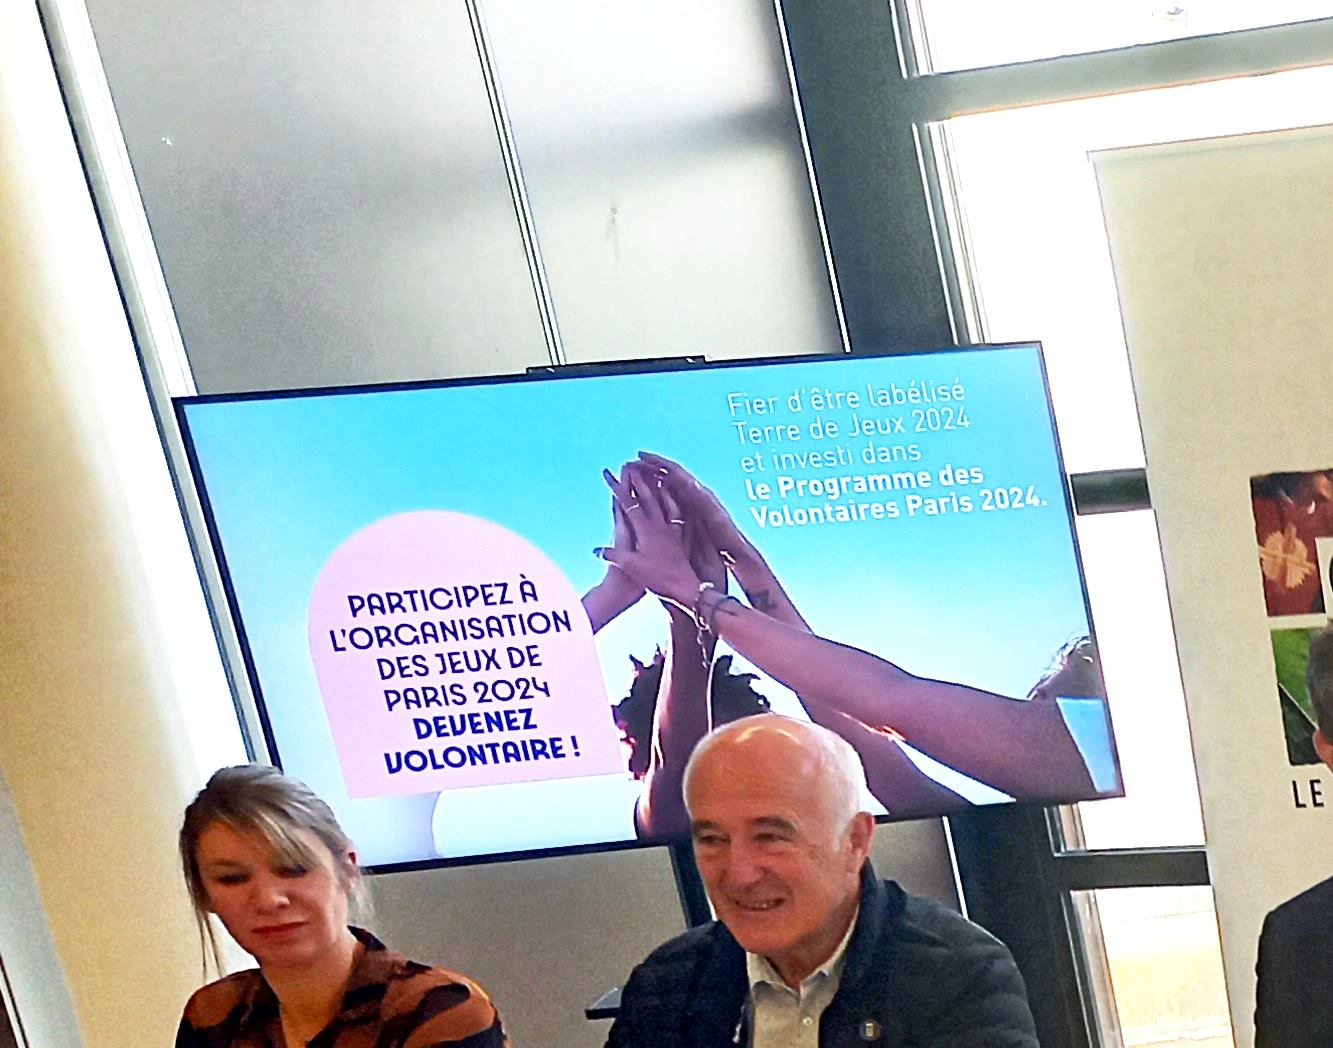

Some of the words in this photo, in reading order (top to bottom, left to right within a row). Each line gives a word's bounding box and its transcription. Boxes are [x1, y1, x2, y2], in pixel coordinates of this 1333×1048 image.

[727, 391, 778, 416] Fier
[788, 386, 860, 413] d'être
[868, 377, 966, 406] labélisé
[732, 421, 801, 444] Terre
[810, 416, 839, 440] de
[849, 413, 905, 437] Jeux
[911, 407, 970, 432] 2024
[741, 452, 765, 473] et
[773, 443, 853, 470] investi
[862, 441, 922, 464] dans
[745, 478, 771, 501] le
[777, 470, 931, 500] Programme
[939, 464, 984, 486] des
[750, 498, 900, 528] Volontaires
[906, 492, 974, 516] Paris
[981, 486, 1048, 511] 2024.
[348, 583, 513, 617] PARTICIPEZ
[519, 574, 539, 602] À
[329, 610, 571, 652] L'ORGANISATION
[377, 654, 429, 680] DES
[435, 648, 501, 675] JEUX
[506, 645, 542, 668] DE
[384, 684, 467, 711] PARIS
[473, 677, 551, 703] 2024
[412, 708, 538, 739] DEVENEZ
[384, 737, 566, 774] VOLONTAIRE
[1292, 779, 1324, 808] LE
